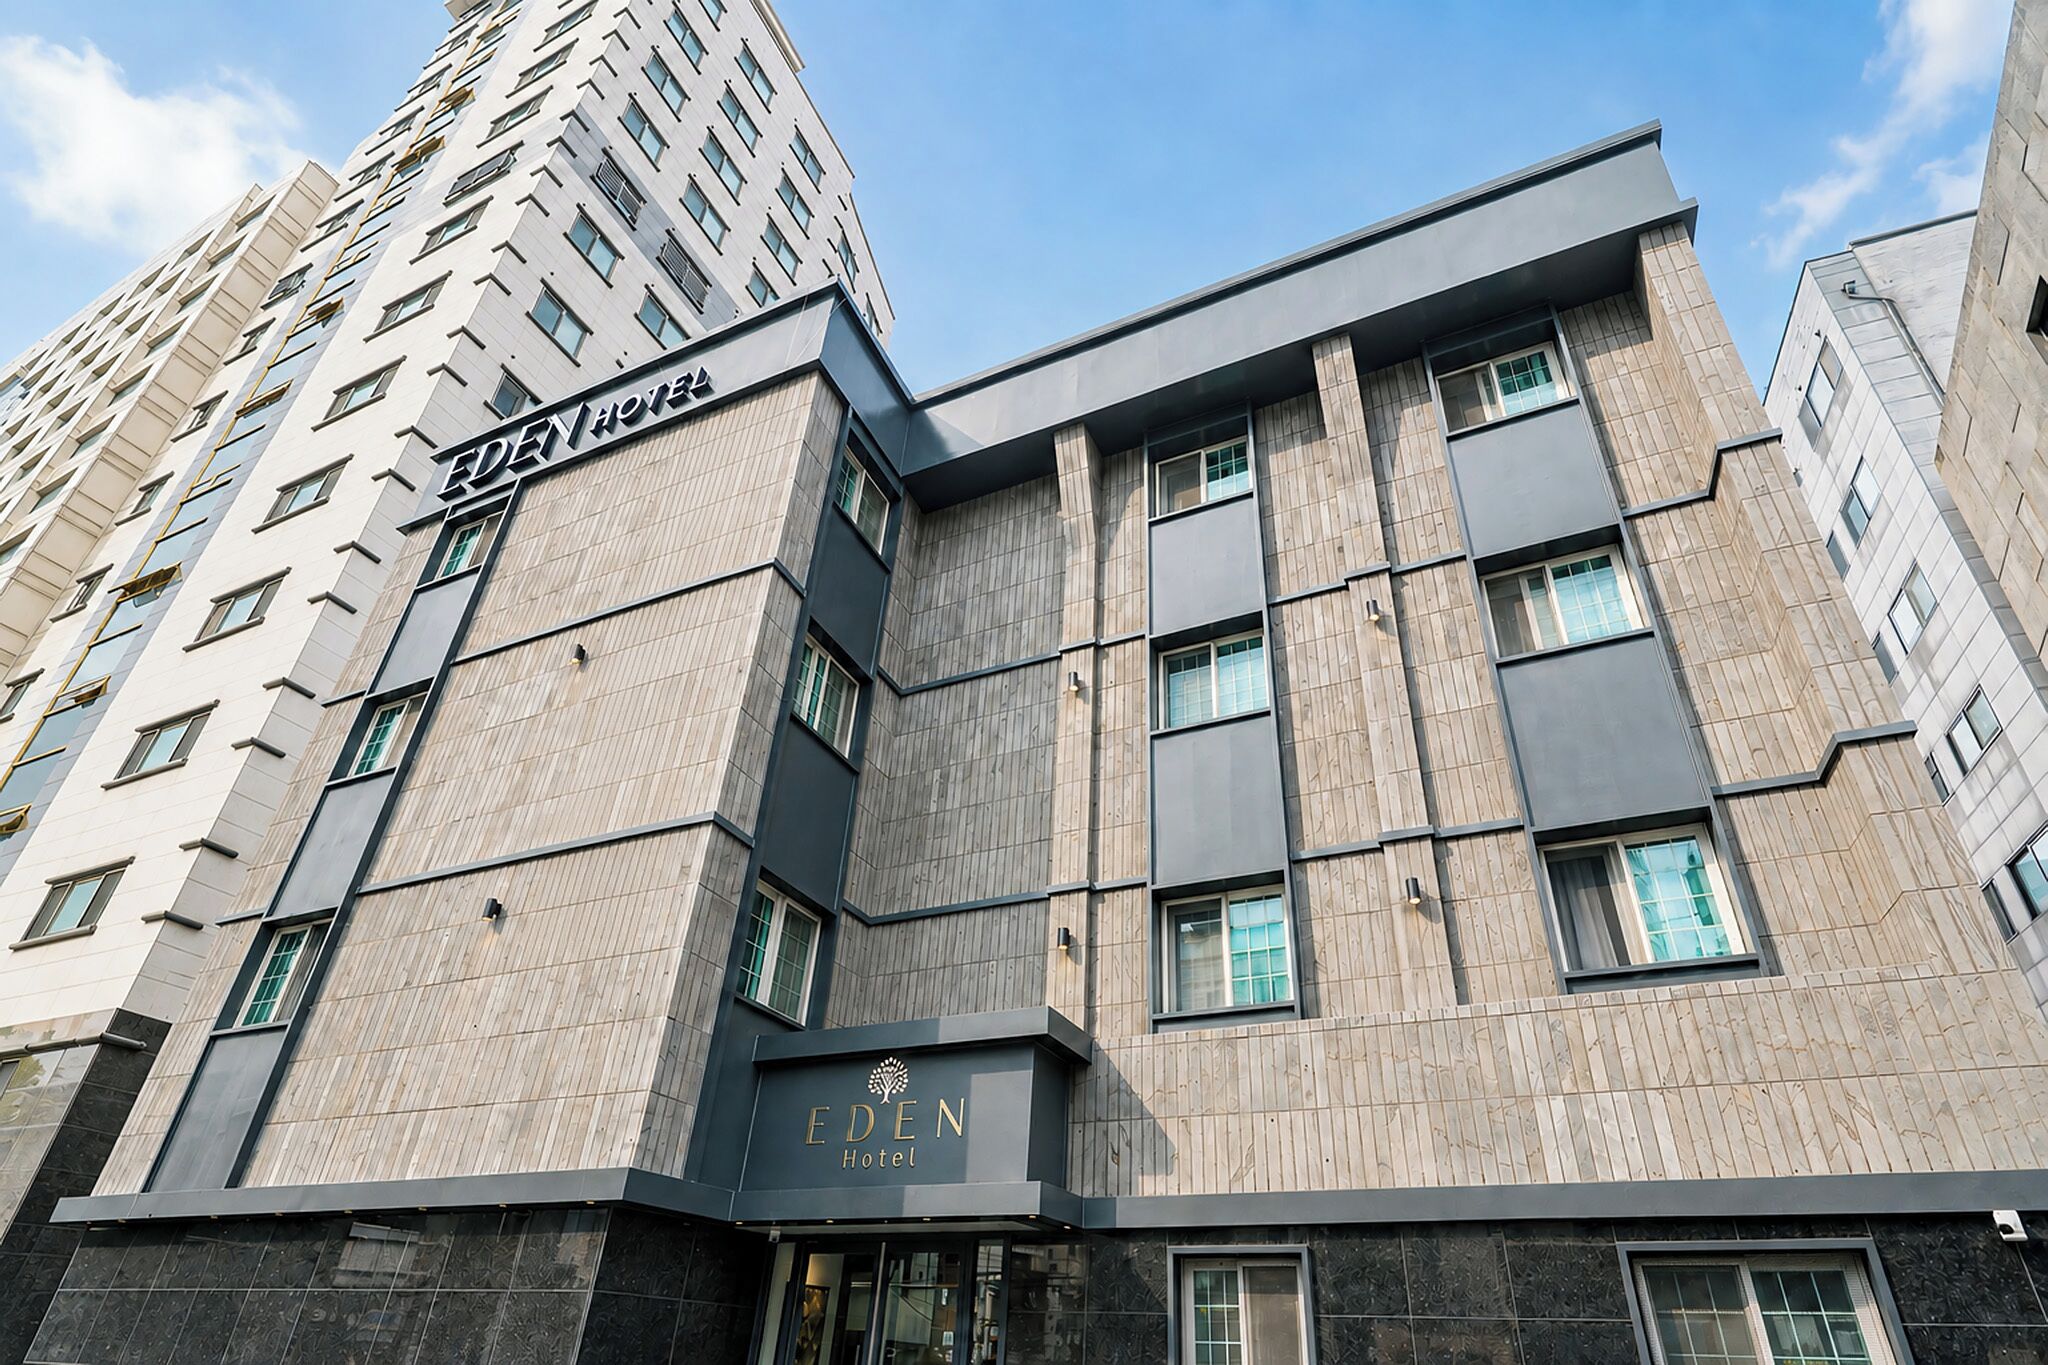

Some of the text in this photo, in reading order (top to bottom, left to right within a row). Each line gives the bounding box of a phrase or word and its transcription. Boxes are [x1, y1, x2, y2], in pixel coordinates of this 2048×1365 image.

[436, 366, 714, 502] EDEN HOTEL
[805, 1098, 966, 1145] EDEN
[842, 1146, 917, 1169] Hotel
